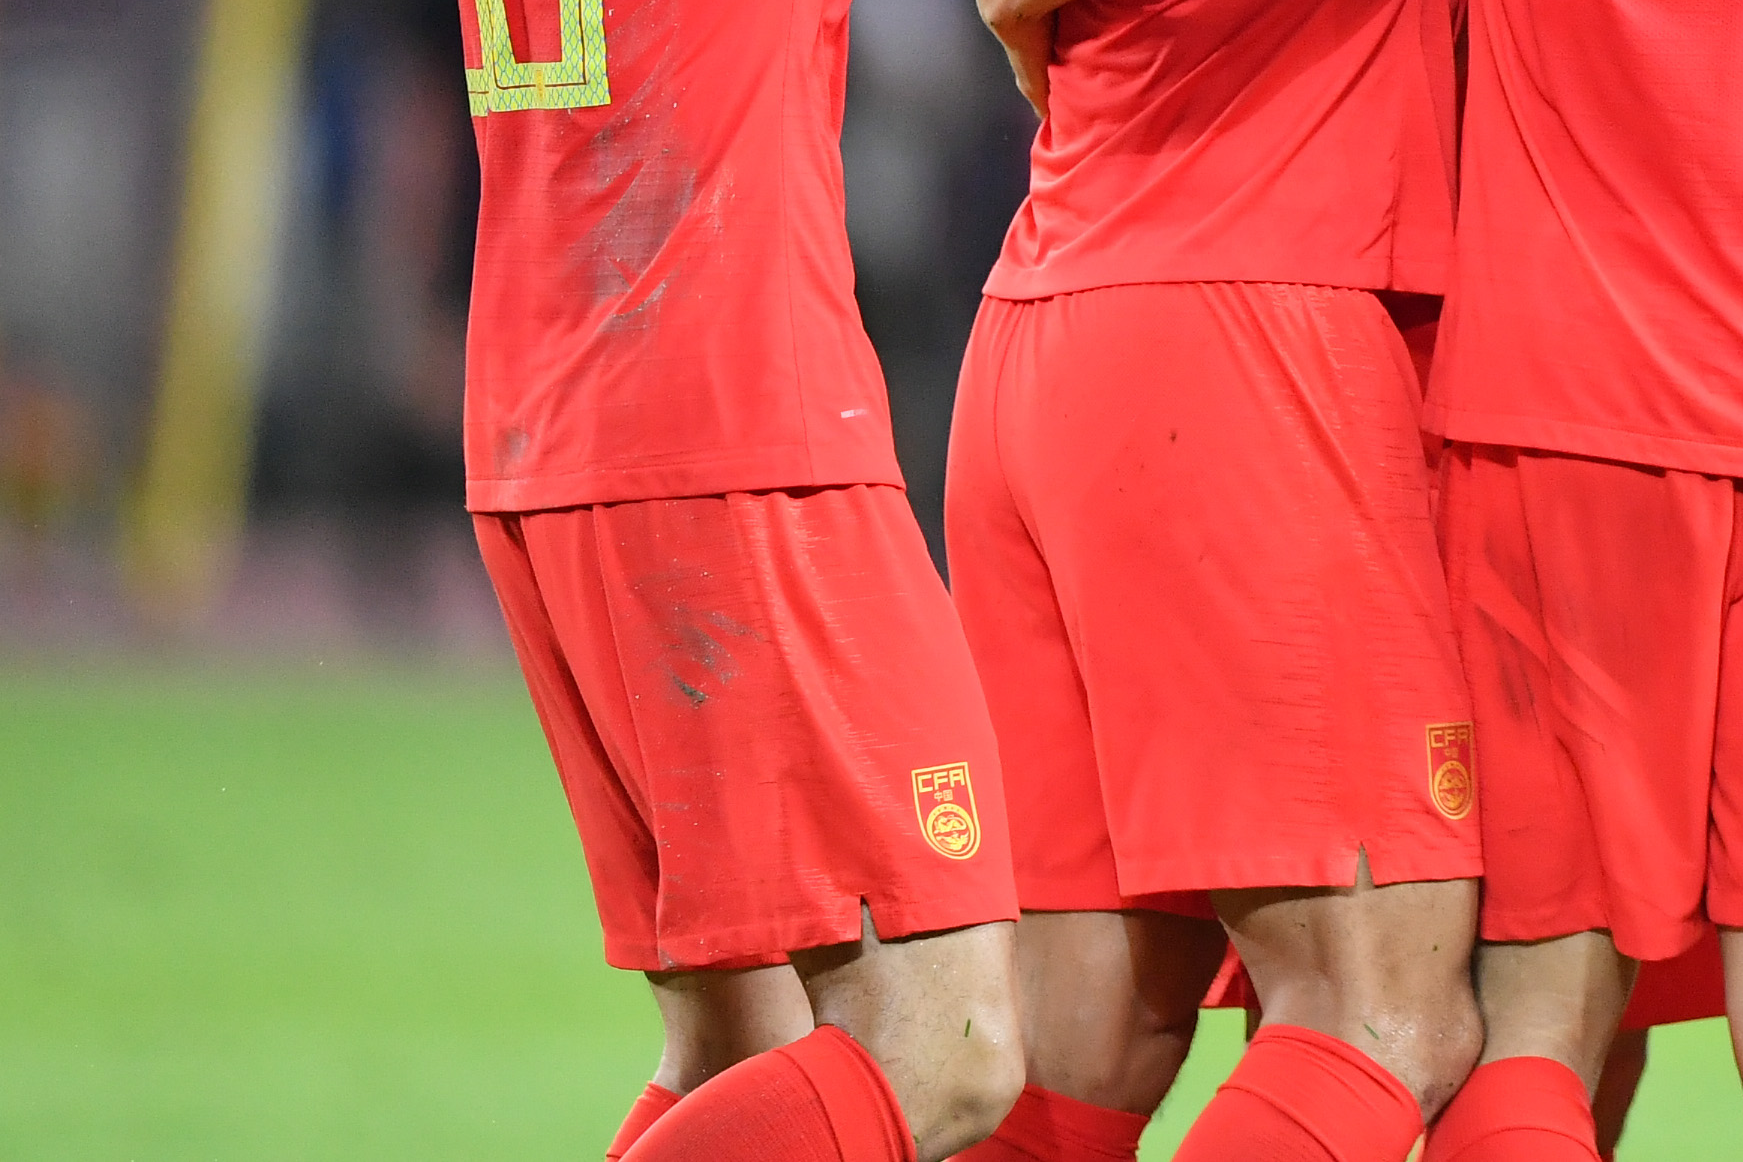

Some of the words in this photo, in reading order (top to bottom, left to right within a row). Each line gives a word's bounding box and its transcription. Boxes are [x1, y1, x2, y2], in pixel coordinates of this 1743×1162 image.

[1430, 729, 1469, 748] CFA
[917, 768, 966, 793] CFA
[933, 789, 954, 802] 中国
